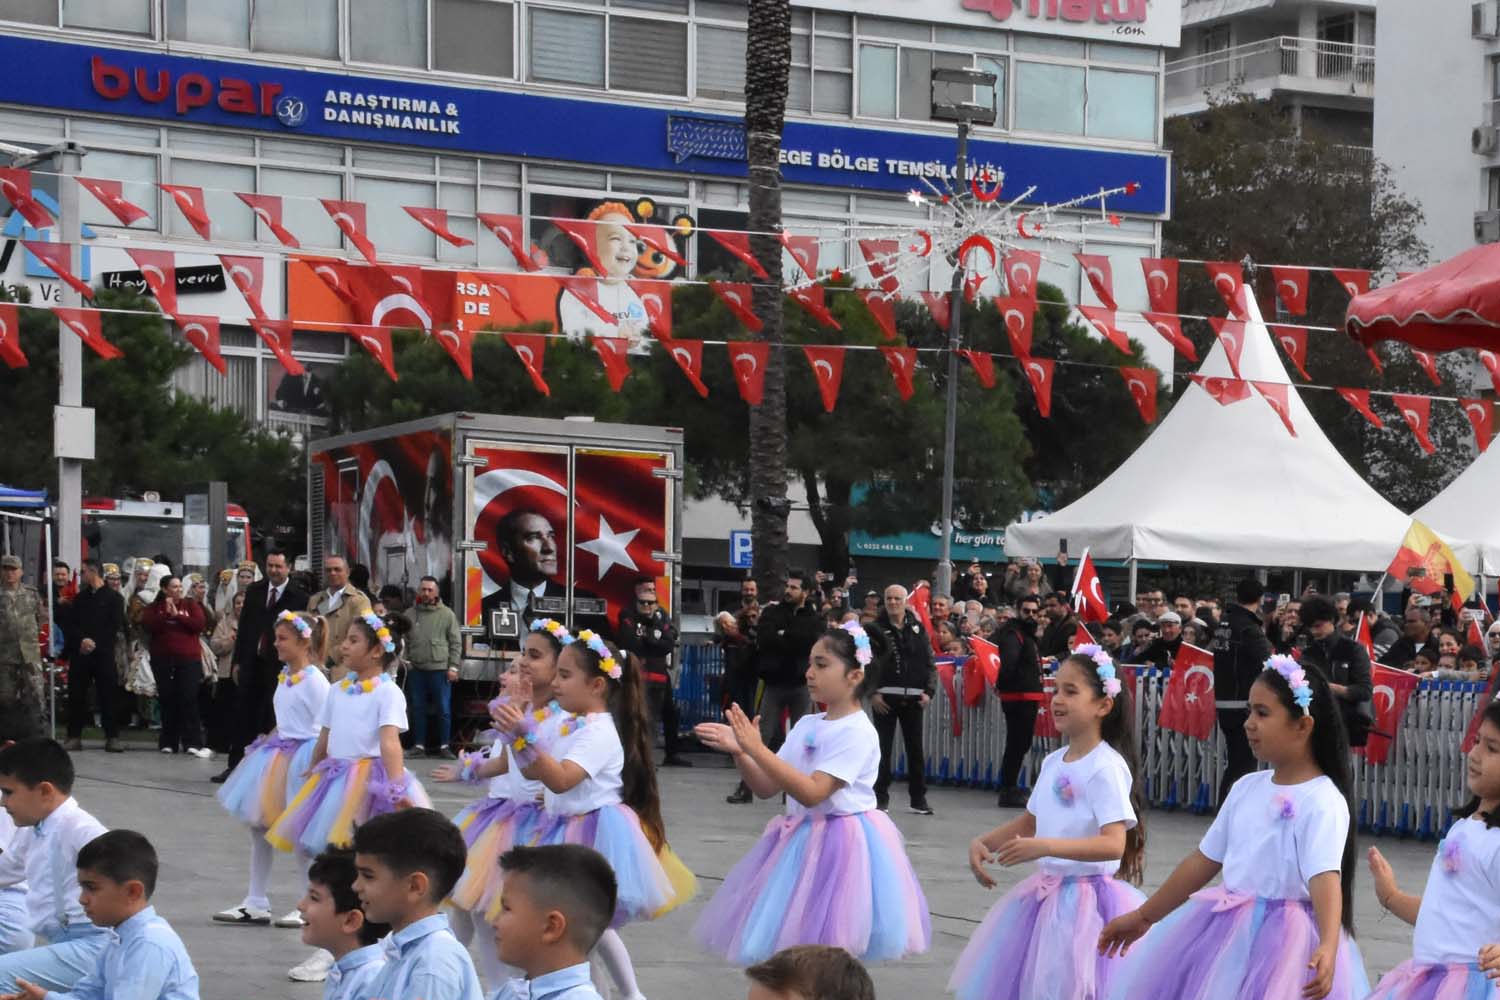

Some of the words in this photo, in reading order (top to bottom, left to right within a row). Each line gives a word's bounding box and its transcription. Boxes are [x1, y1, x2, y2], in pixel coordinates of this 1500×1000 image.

[91, 55, 283, 116] bupar
[277, 100, 304, 119] 30
[324, 89, 441, 114] ARAŞTIRMA
[445, 102, 459, 117] &
[323, 107, 461, 134] DANIŞMANLIK
[778, 149, 812, 166] EGE
[818, 149, 879, 173] BÖLGE
[109, 273, 148, 295] Hay
[177, 273, 220, 286] verir
[456, 281, 490, 297] RSA
[734, 532, 753, 564] P
[954, 532, 974, 544] her
[974, 533, 994, 549] gün
